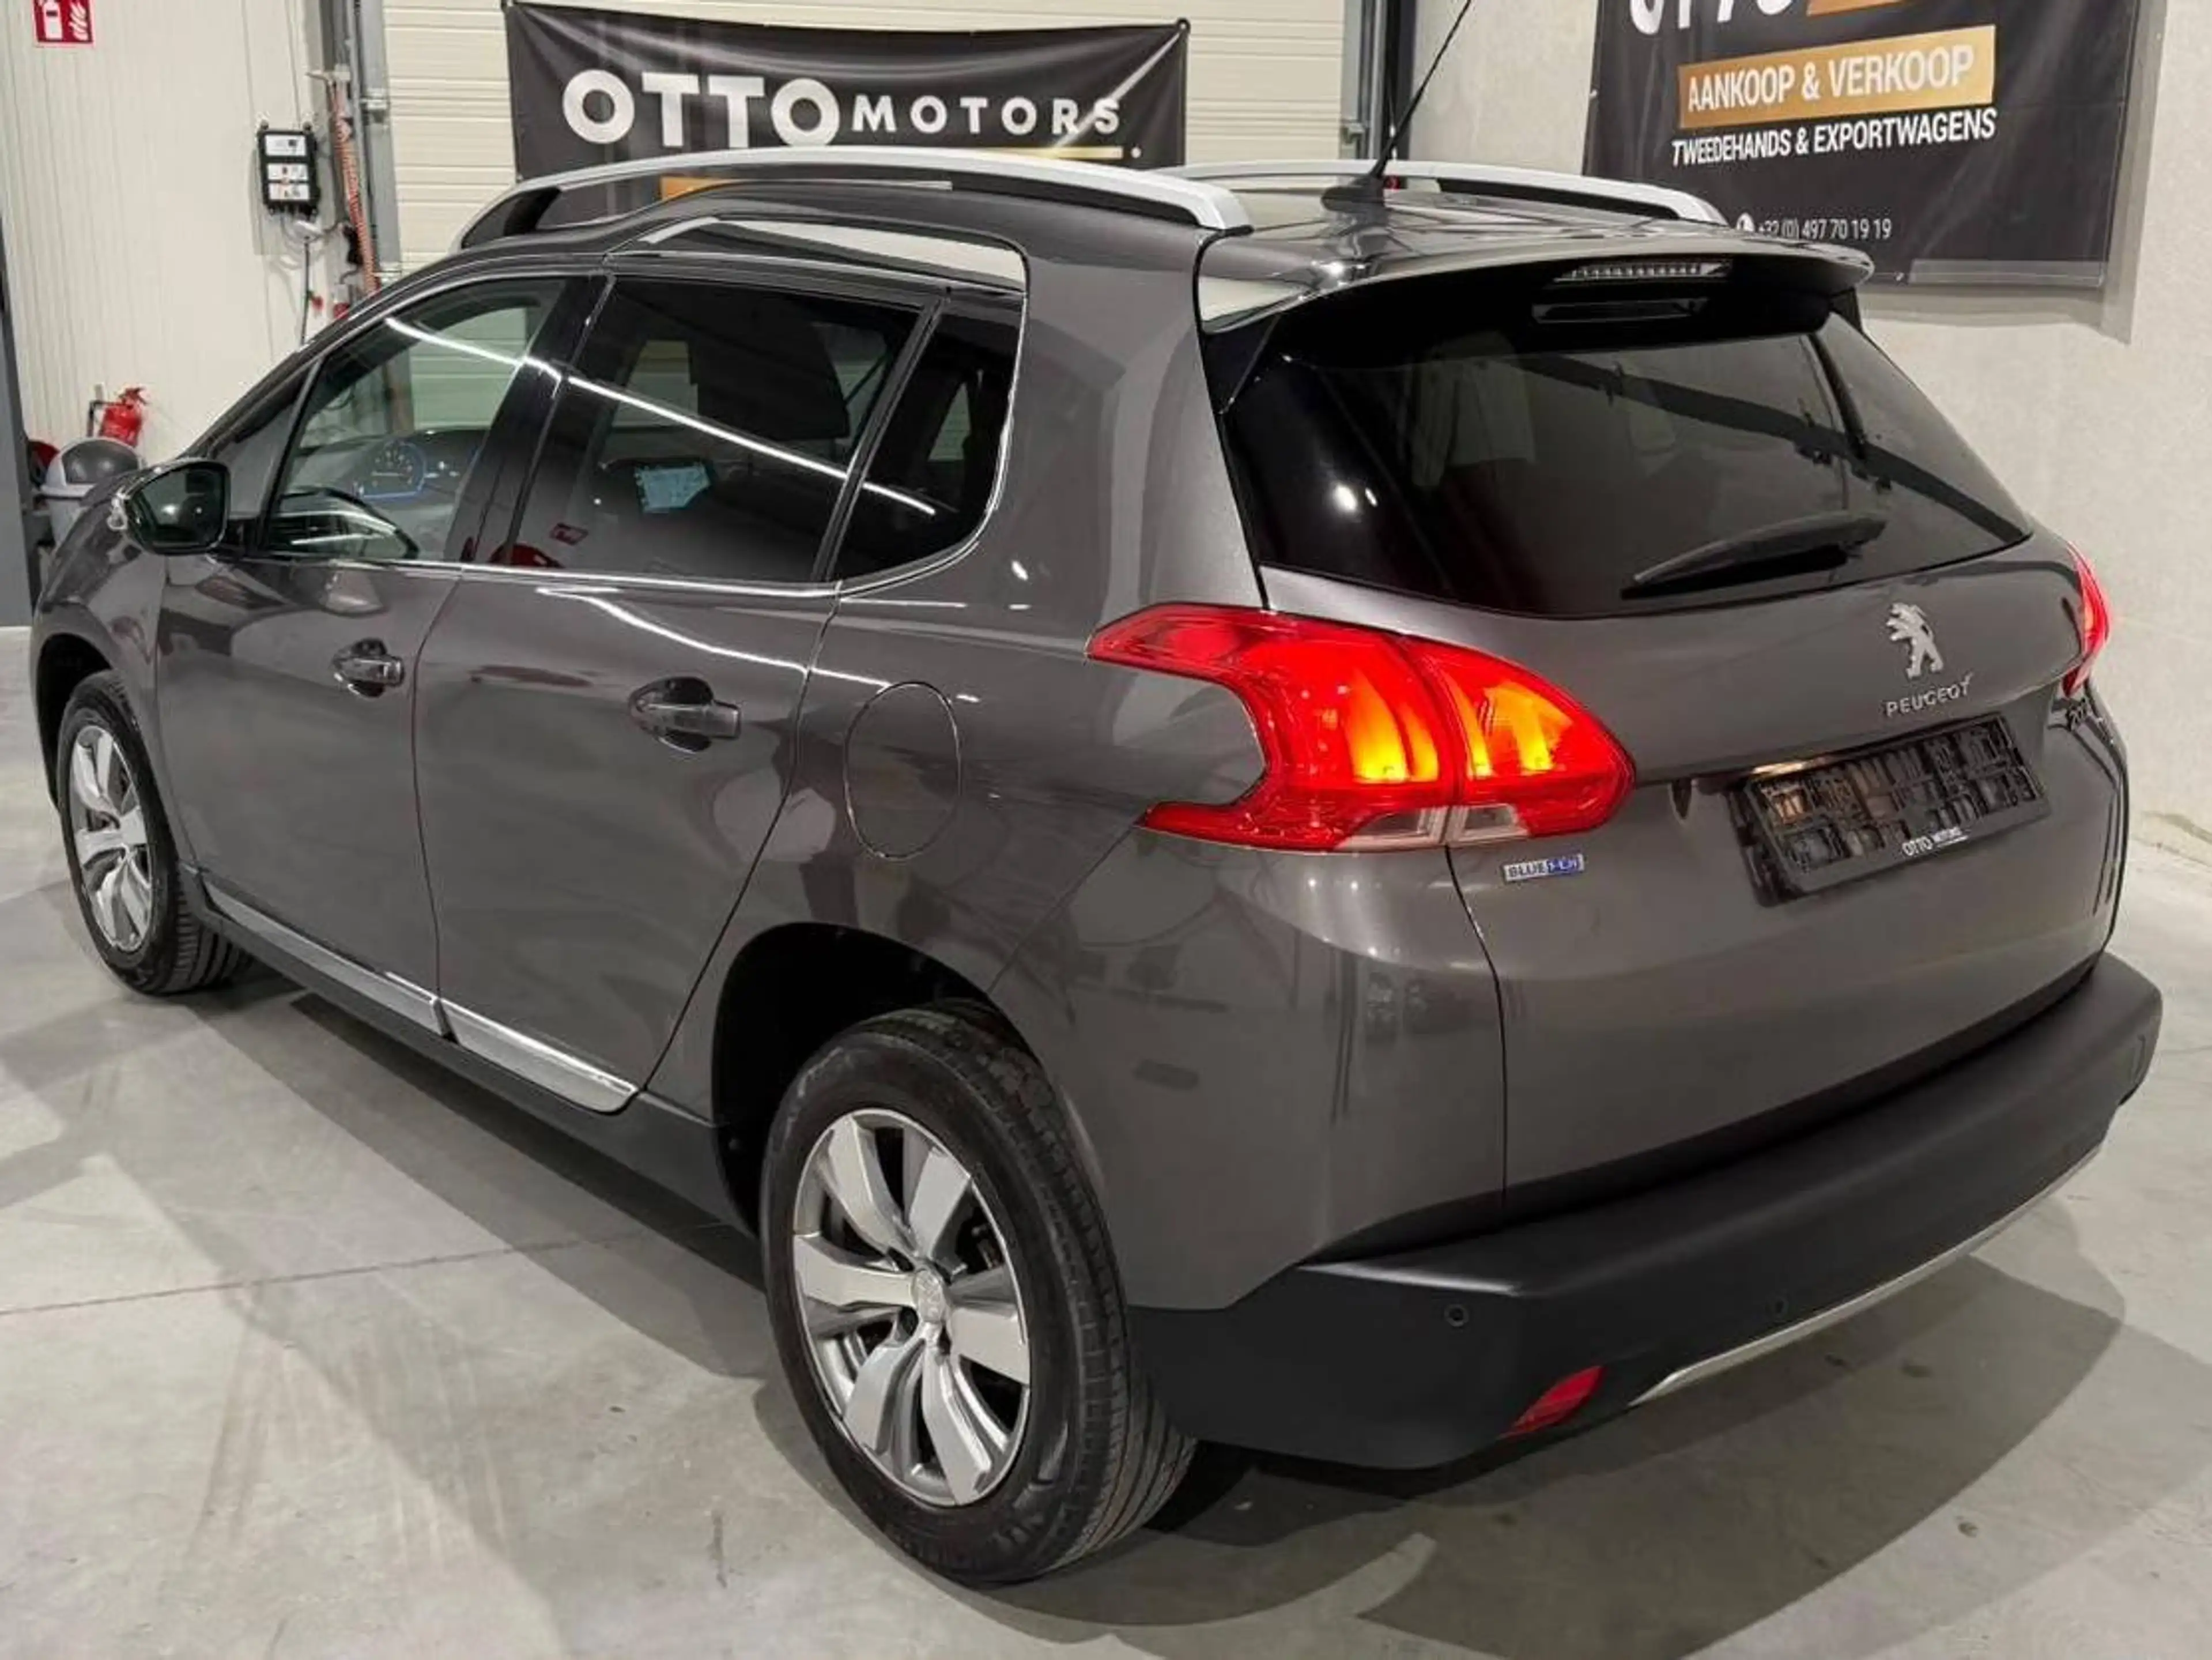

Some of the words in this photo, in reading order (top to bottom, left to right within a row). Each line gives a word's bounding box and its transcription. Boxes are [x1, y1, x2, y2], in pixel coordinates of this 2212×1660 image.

[563, 69, 840, 148] OTTO
[852, 95, 1119, 135] MOTORS
[1688, 64, 1795, 113] AANKOOP
[1802, 61, 1821, 100] &
[1828, 44, 1975, 98] VERKOOP
[1672, 128, 1791, 167] TWEEDEHANDS
[1796, 127, 1809, 154] &
[1813, 107, 1997, 153] EXPORTWAGENS
[1802, 218, 1827, 239] 497
[1829, 218, 1848, 240] 70
[1851, 218, 1870, 239] 19
[1873, 218, 1892, 239] 19
[1886, 671, 1974, 718] PEUGEOT
